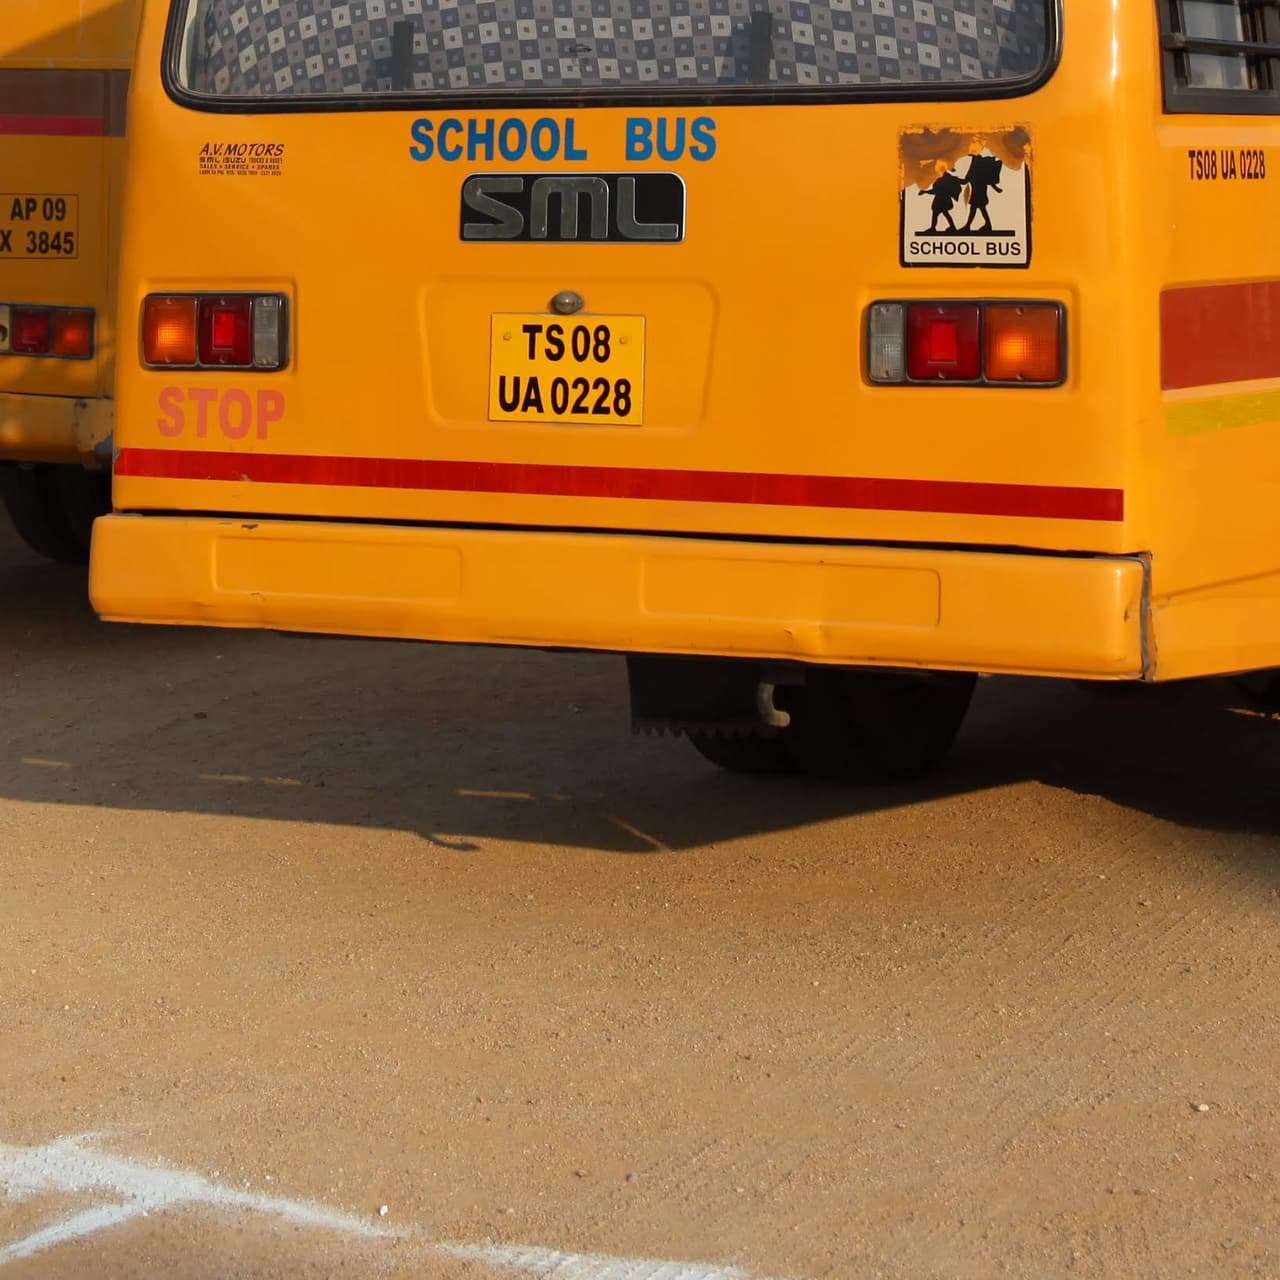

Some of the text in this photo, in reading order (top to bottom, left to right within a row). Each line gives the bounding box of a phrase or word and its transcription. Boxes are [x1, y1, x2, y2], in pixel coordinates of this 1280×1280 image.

[409, 117, 717, 162] SCHOOL BUS
[1188, 150, 1266, 180] TS08 UA 0228
[10, 197, 67, 222] AP 09
[463, 176, 681, 240] SML
[0, 229, 74, 255] X 3845
[909, 241, 1021, 256] SCHOOL BUS
[157, 385, 286, 441] STOP
